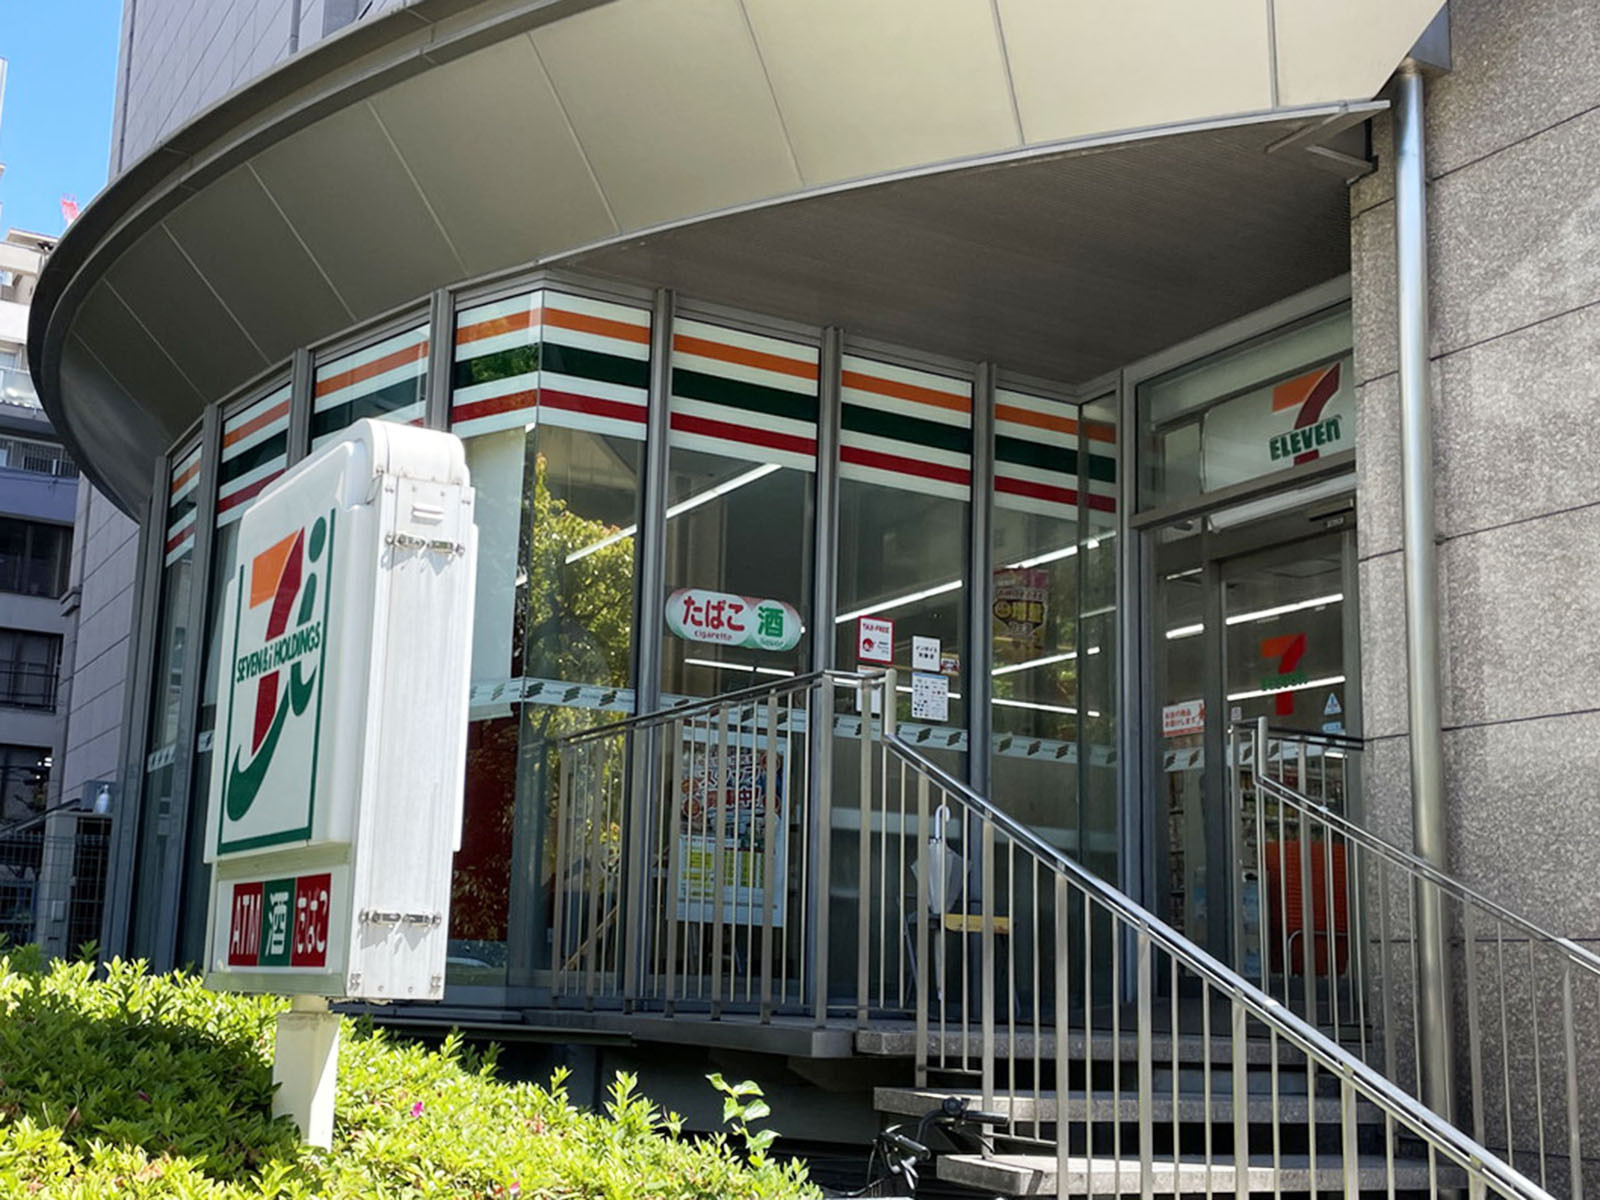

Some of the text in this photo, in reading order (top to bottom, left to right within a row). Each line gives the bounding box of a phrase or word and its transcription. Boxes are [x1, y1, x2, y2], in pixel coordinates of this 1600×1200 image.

[682, 595, 784, 638] たばこ 酒
[273, 620, 321, 668] HOLDINGS
[231, 893, 261, 955] ATM
[265, 891, 289, 957] 酒
